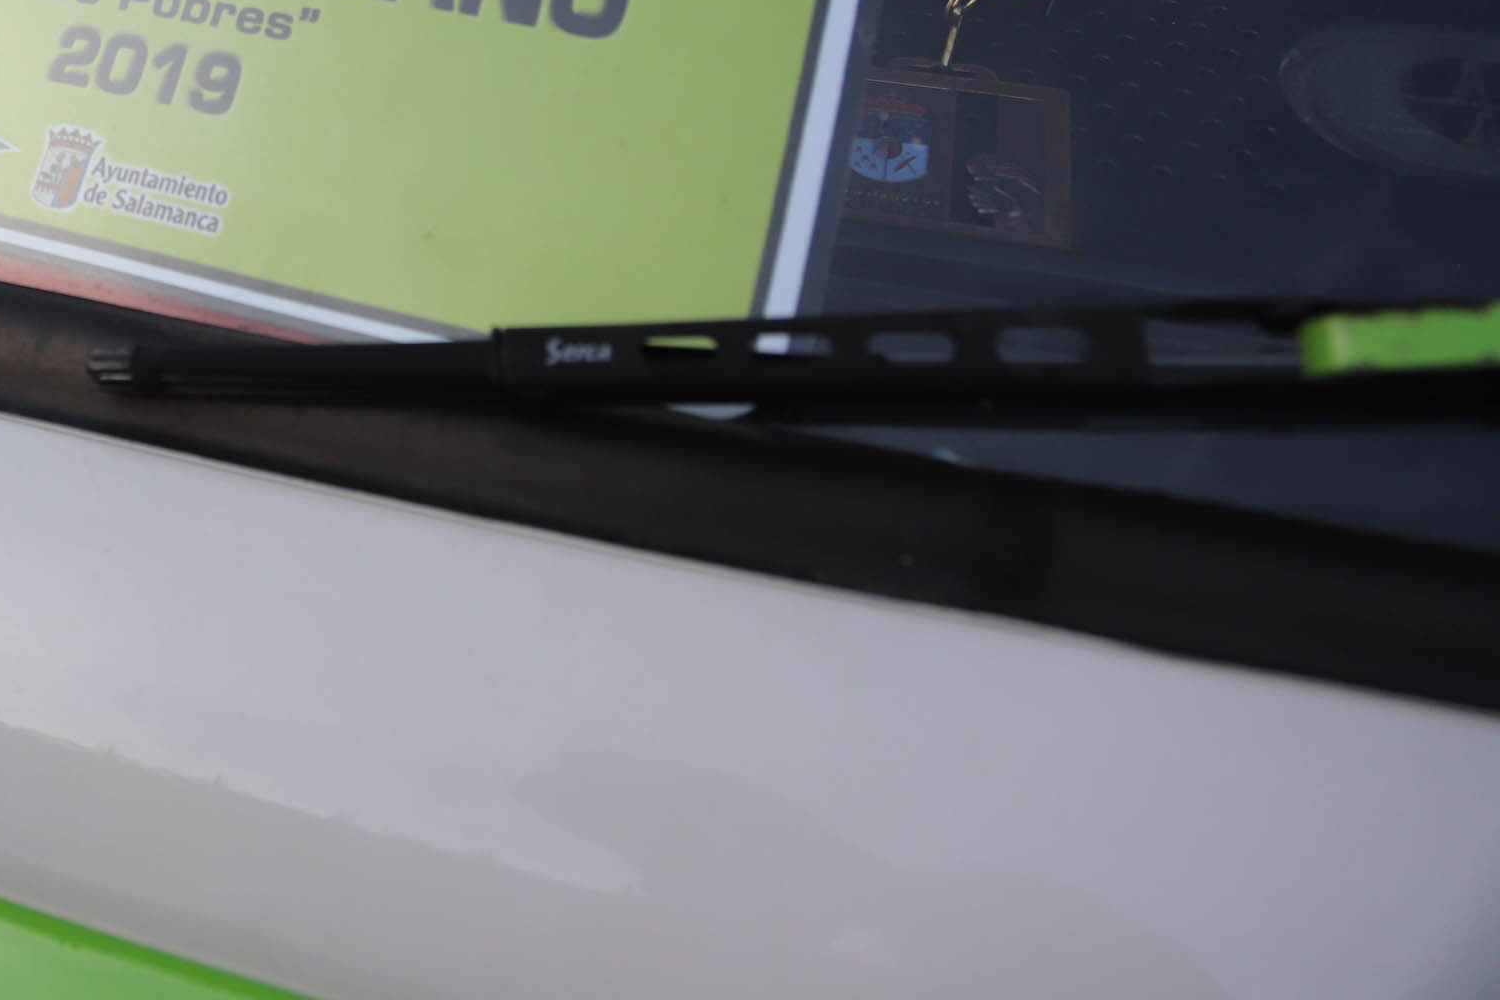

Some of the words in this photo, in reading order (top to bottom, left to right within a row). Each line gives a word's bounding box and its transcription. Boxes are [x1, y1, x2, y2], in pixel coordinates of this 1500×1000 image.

[48, 24, 243, 116] 2019
[91, 157, 228, 206] Ayuntamiento
[84, 183, 108, 206] de
[111, 188, 220, 233] Salamanca
